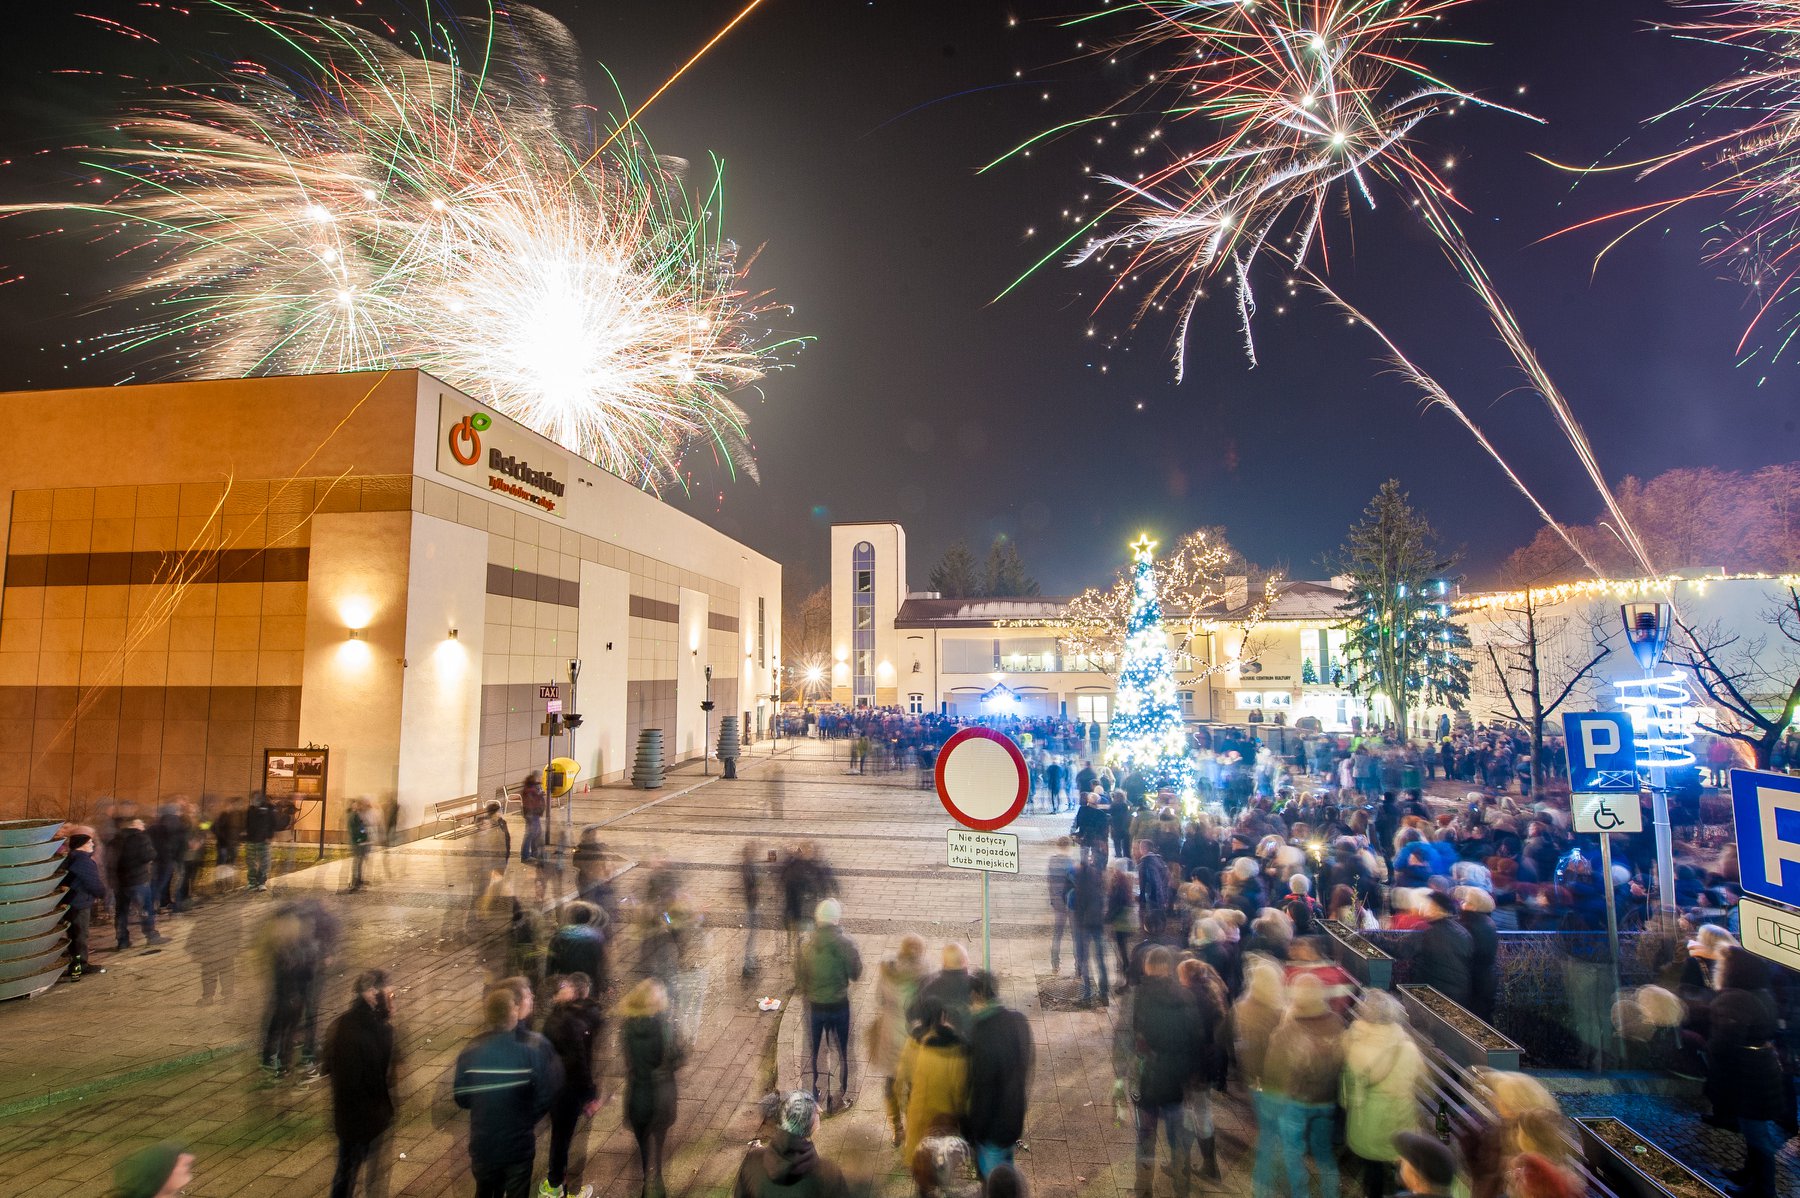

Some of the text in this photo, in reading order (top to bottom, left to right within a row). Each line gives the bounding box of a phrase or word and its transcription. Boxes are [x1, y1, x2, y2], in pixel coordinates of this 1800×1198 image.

[541, 687, 558, 697] TAXI
[1580, 719, 1621, 769] P
[958, 833, 1007, 847] Nie dotyczy
[950, 843, 967, 853] TAXI
[975, 847, 1016, 857] pojazdów
[952, 856, 1015, 869] służb miejskich
